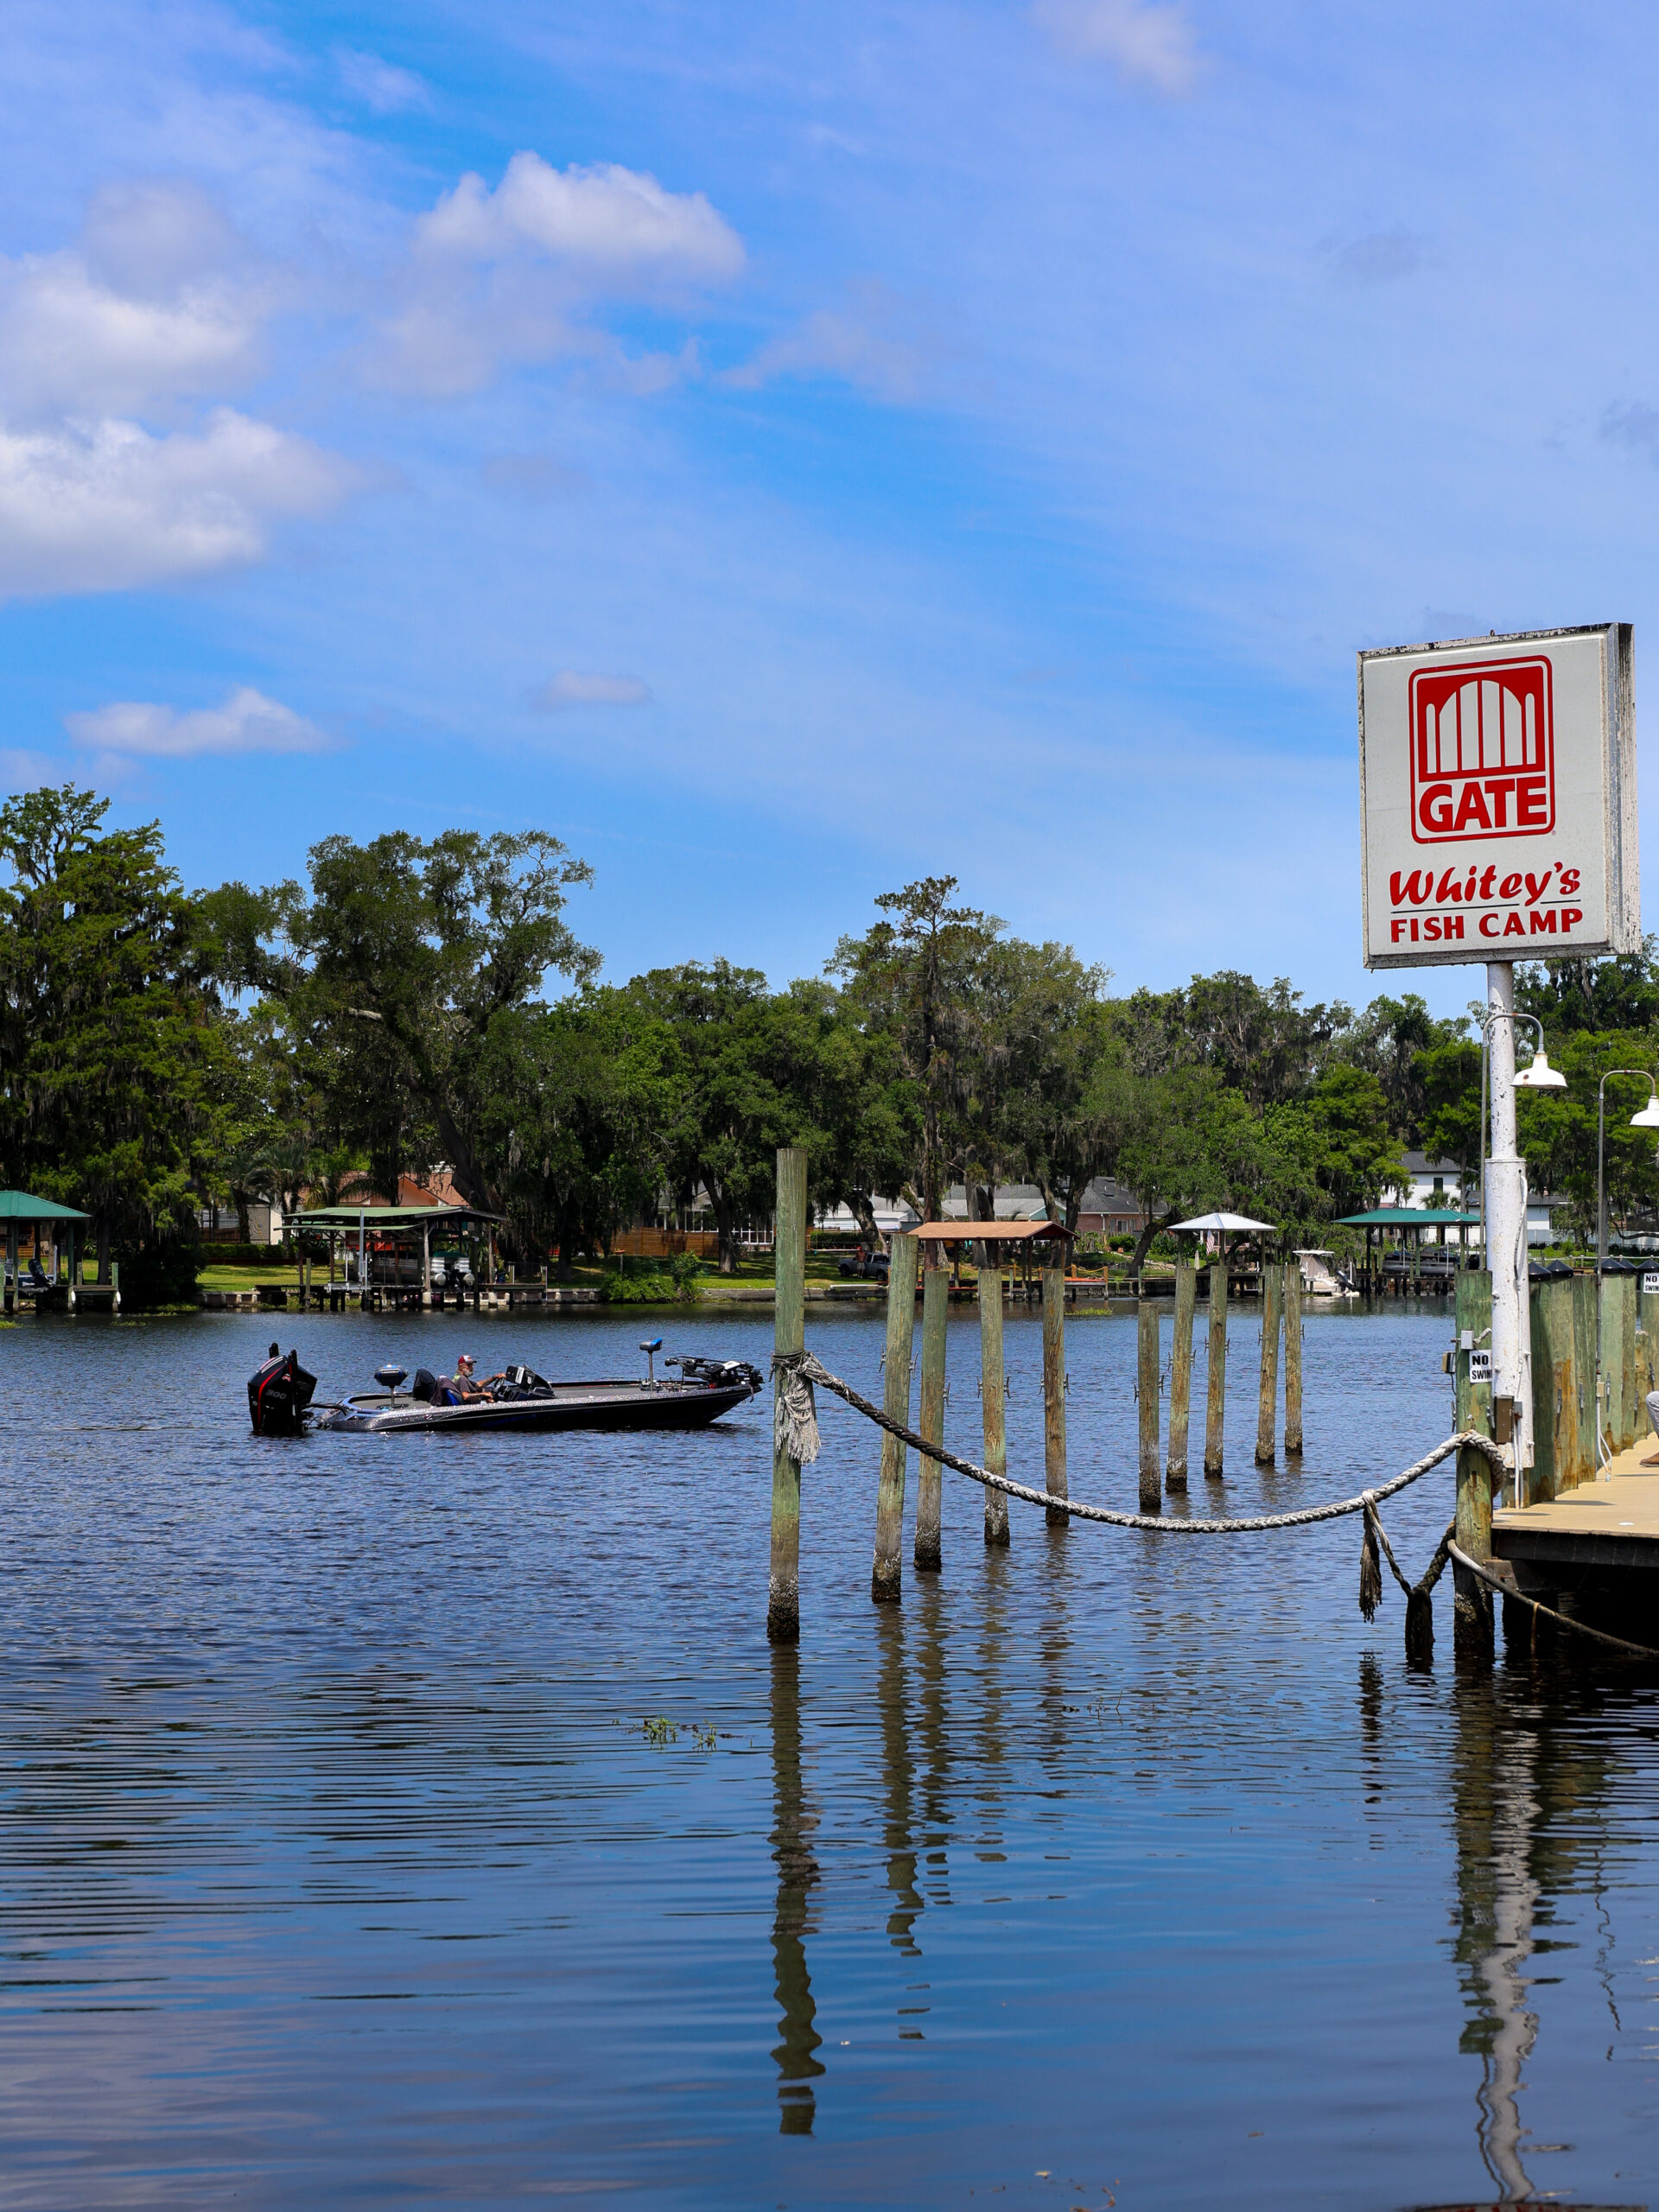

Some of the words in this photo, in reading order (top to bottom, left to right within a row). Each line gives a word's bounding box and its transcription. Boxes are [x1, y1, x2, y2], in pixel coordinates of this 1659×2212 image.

[1419, 776, 1548, 833] GATE
[1389, 861, 1581, 907] Whitey's
[1390, 915, 1465, 944] FISH
[1478, 908, 1584, 938] CAMP
[1471, 1354, 1490, 1366] NO
